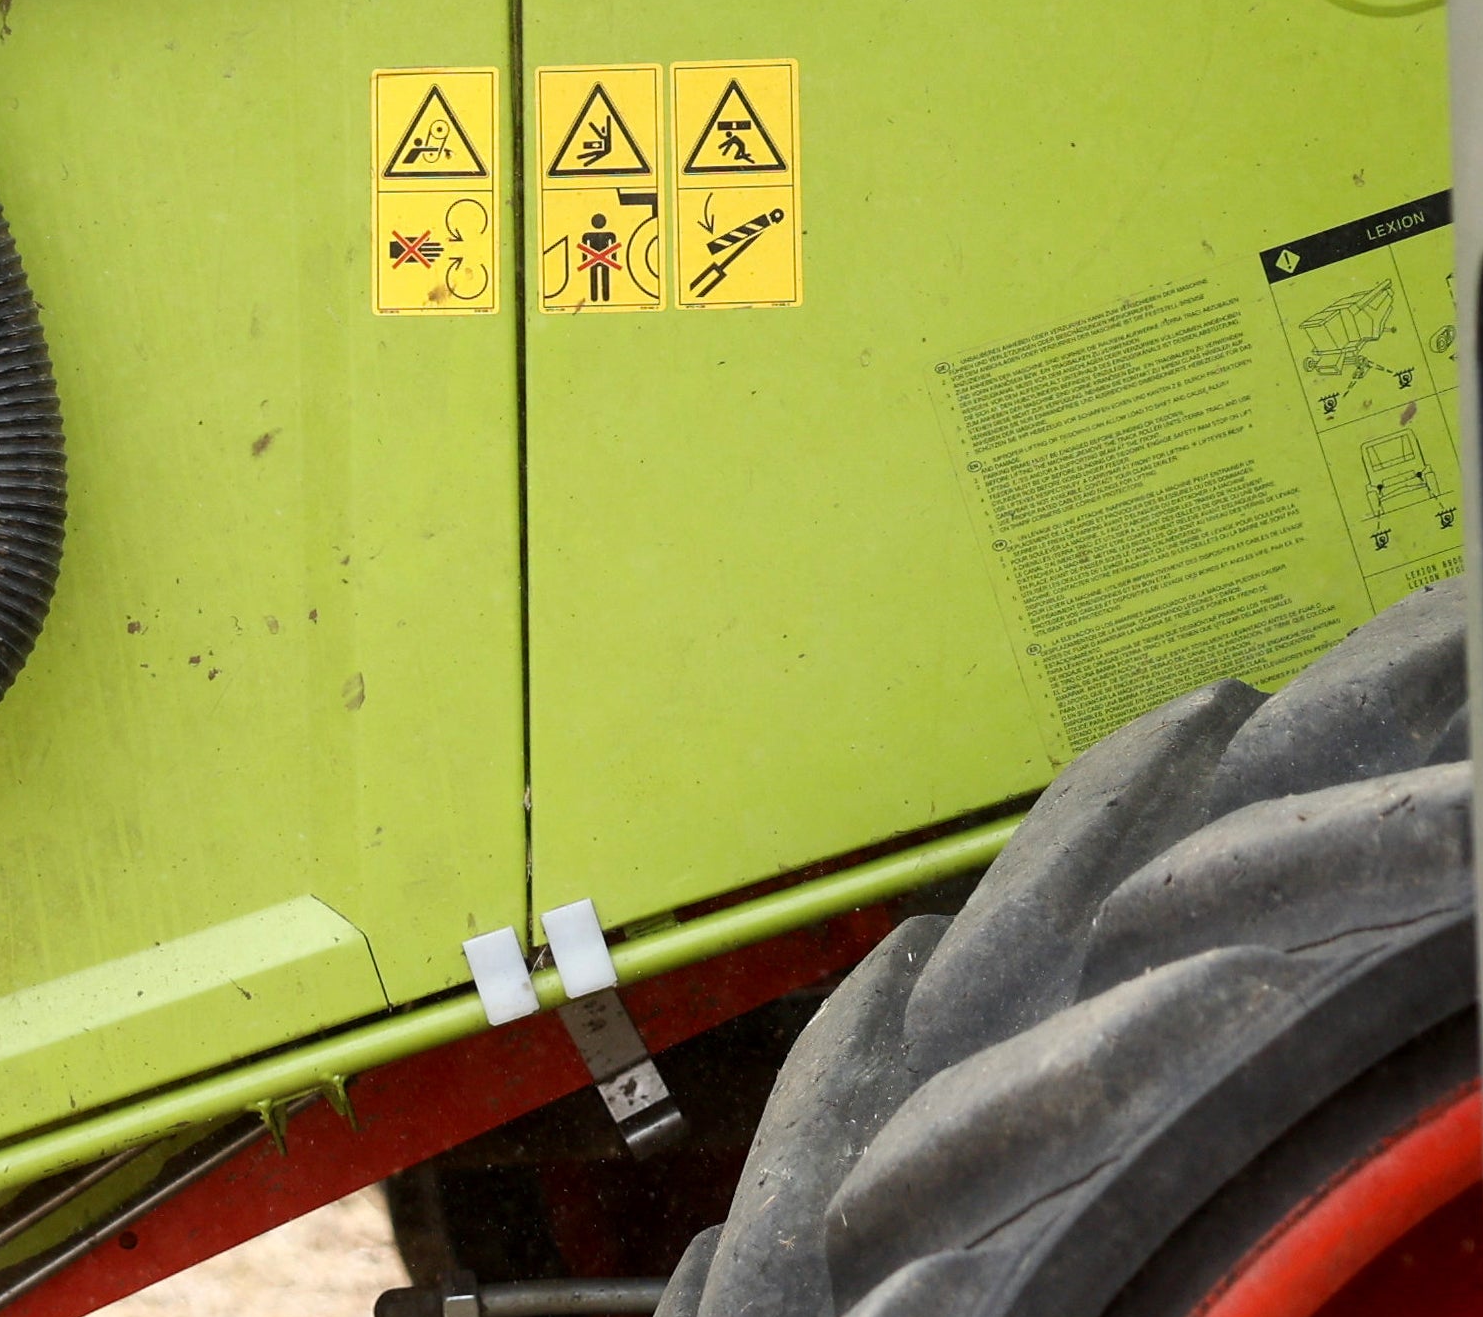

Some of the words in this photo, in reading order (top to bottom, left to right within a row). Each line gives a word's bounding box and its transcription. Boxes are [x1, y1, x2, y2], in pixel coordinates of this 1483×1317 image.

[1365, 210, 1425, 241] LEXION
[1404, 565, 1437, 581] LEXION
[1408, 573, 1440, 590] LEXION
